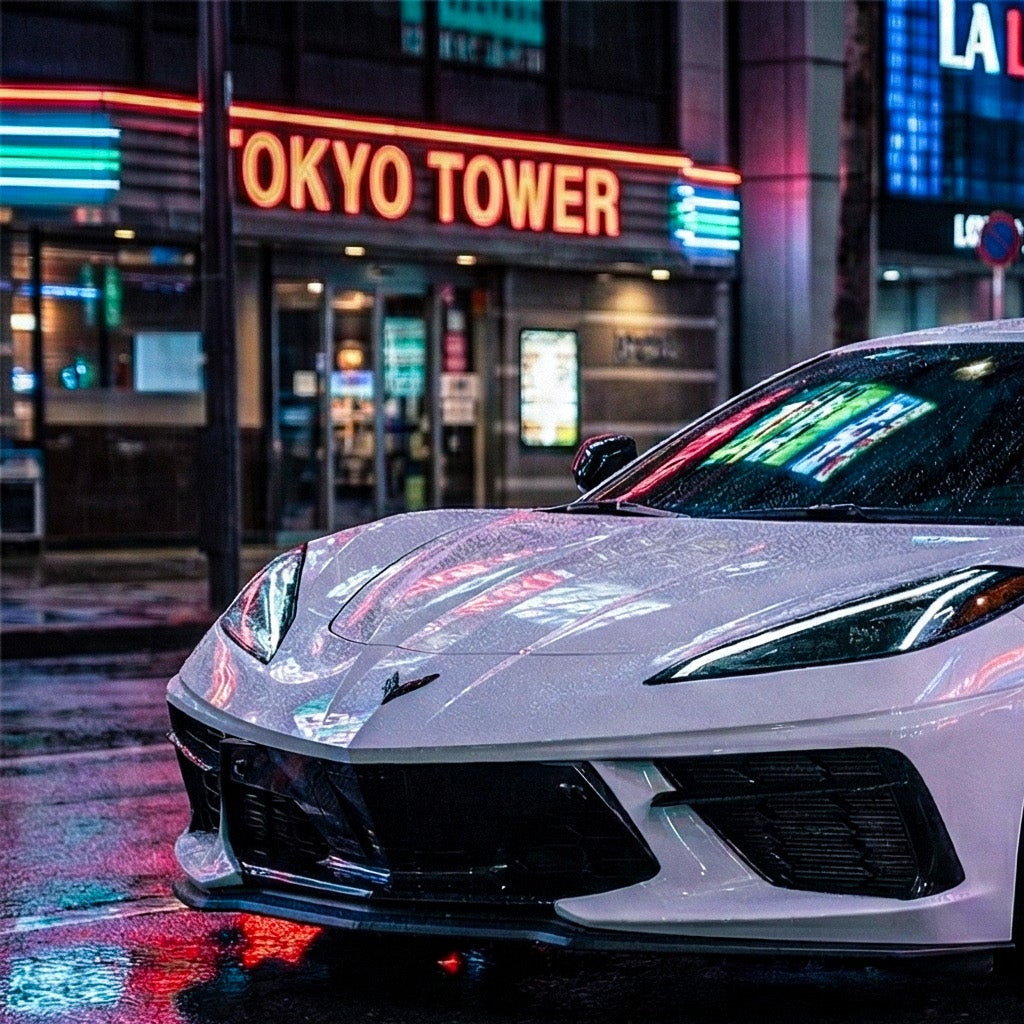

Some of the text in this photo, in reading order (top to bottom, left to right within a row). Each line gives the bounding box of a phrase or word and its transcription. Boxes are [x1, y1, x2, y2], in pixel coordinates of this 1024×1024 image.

[939, 0, 1000, 74] LA
[229, 129, 620, 237] OKYO TOWER
